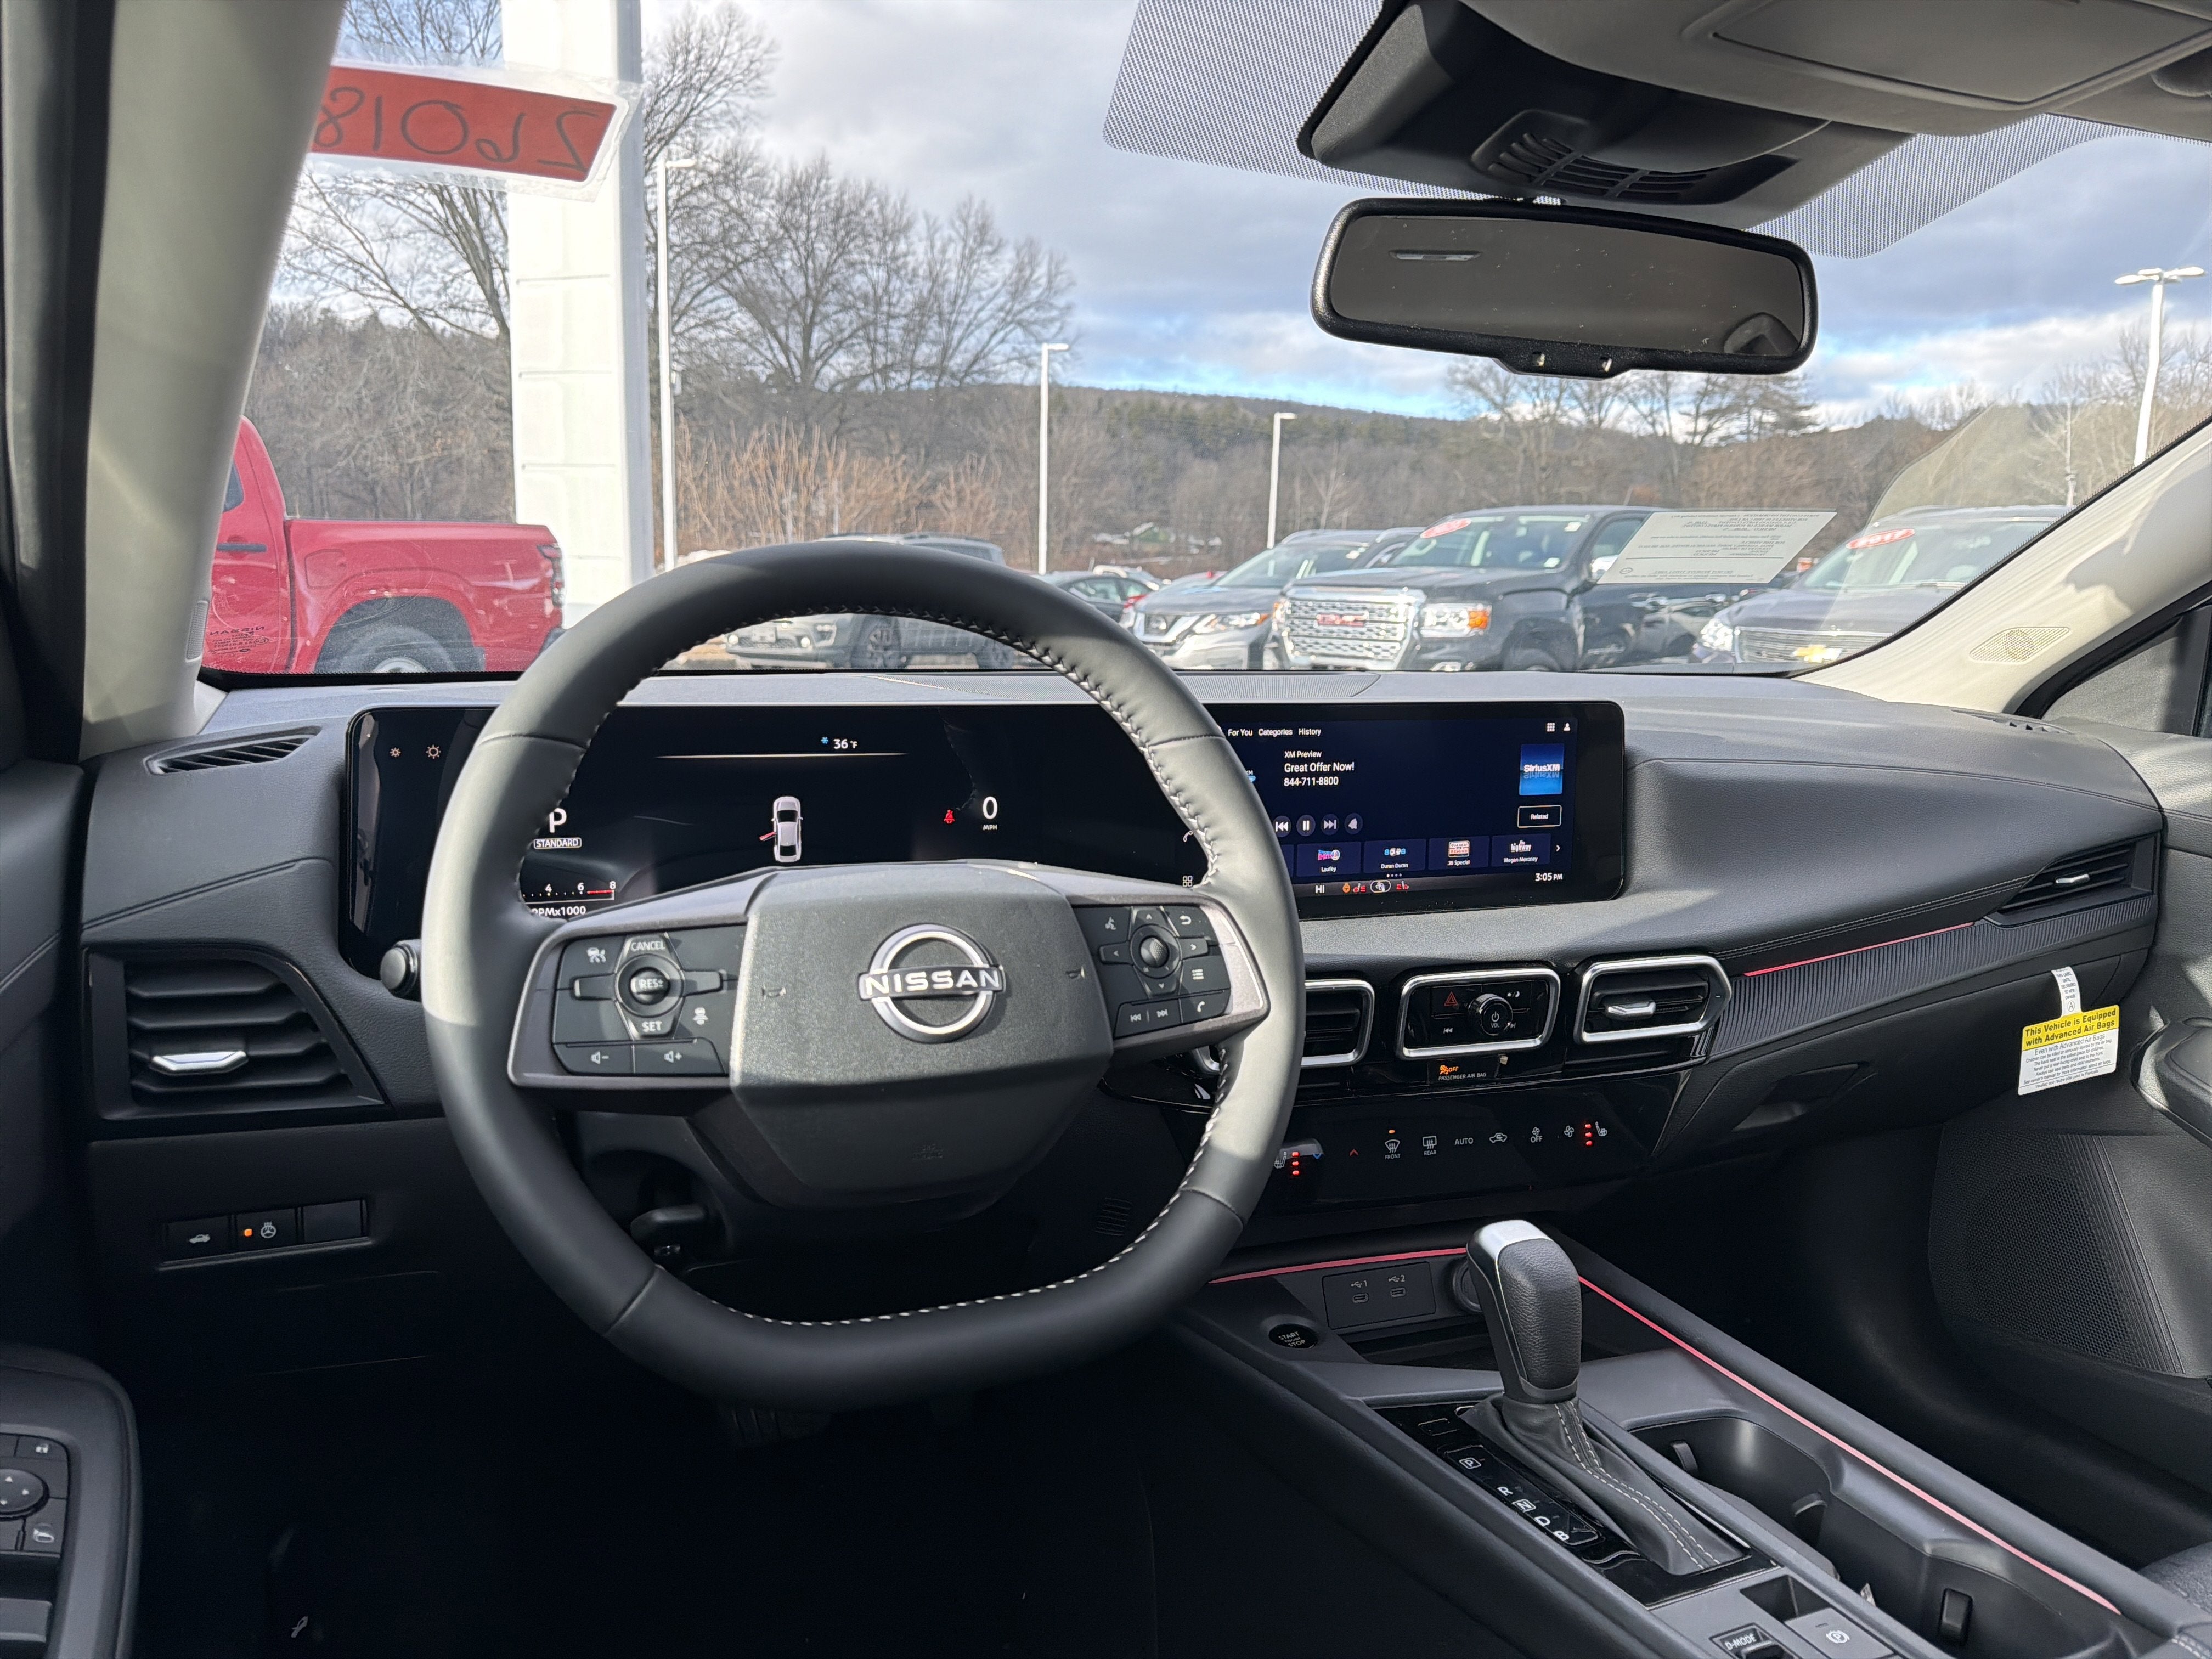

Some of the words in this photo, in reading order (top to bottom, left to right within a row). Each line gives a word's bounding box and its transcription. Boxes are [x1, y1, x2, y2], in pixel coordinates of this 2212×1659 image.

[1259, 729, 1293, 737] Categories
[1299, 728, 1321, 736] History
[833, 739, 848, 749] 36
[1284, 763, 1307, 772] Great
[1310, 763, 1331, 772] Offer
[1333, 762, 1355, 771] Now!
[1523, 764, 1560, 772] SiriusXM
[1284, 777, 1339, 786] 844-711-8800
[983, 797, 998, 820] 0
[549, 808, 567, 833] P
[535, 838, 579, 848] STANDARD
[1511, 843, 1532, 853] highway
[1535, 873, 1553, 882] 3:05
[545, 884, 552, 892] 4
[578, 883, 584, 891] 6
[1316, 885, 1325, 894] HI
[631, 940, 665, 951] CANCEL
[865, 970, 1000, 995] NISSAN
[642, 1021, 662, 1032] SET
[2025, 1026, 2041, 1037] This
[2043, 1019, 2071, 1032] Vehicle
[2073, 1017, 2080, 1025] is
[2083, 1008, 2116, 1024] Equipped
[2025, 1036, 2042, 1047] with
[2045, 1026, 2081, 1042] Advanced
[2084, 1023, 2094, 1032] Air
[2096, 1018, 2115, 1031] Bags
[2035, 1047, 2047, 1055] Even
[2059, 1038, 2083, 1049] Advanced
[2092, 1032, 2105, 1042] Bags
[1278, 1331, 1299, 1340] START
[1497, 1486, 1513, 1496] R
[1516, 1501, 1532, 1510] N
[1534, 1516, 1550, 1527] D
[1553, 1531, 1569, 1541] B
[1724, 1633, 1757, 1650] D-MODE
